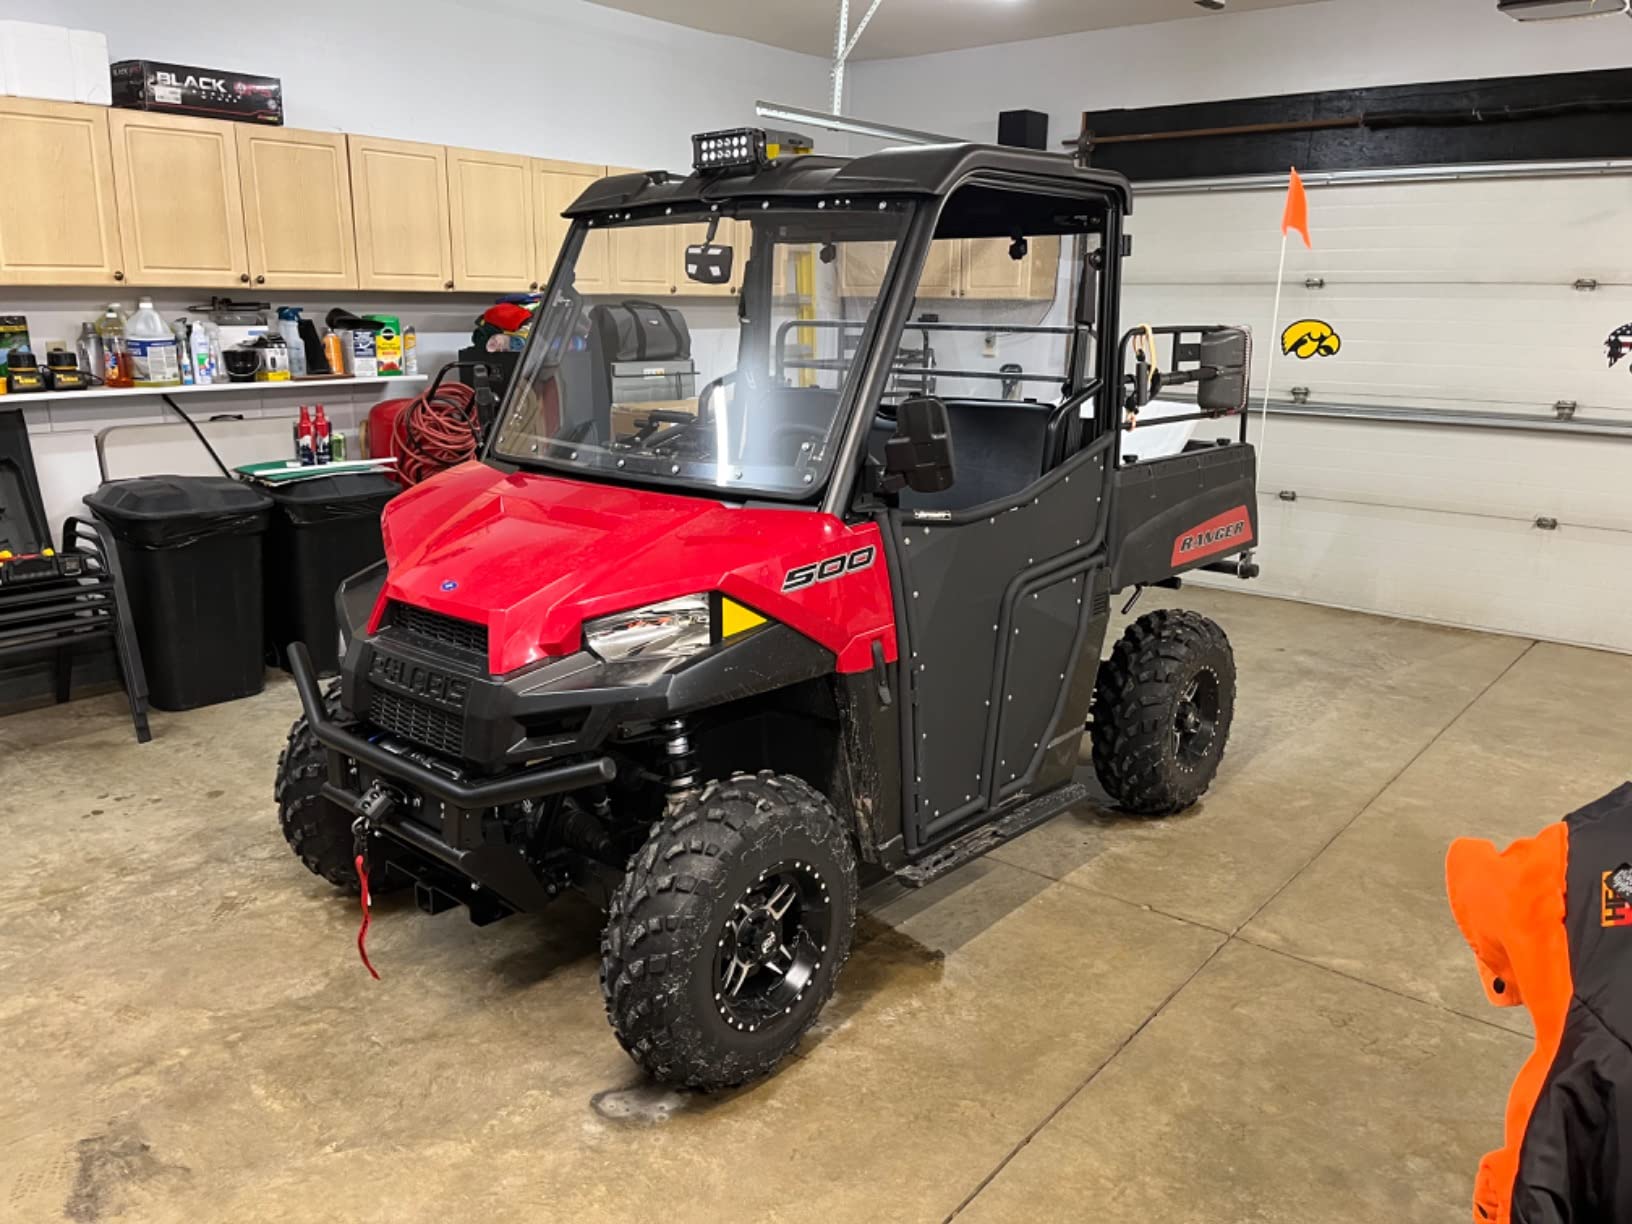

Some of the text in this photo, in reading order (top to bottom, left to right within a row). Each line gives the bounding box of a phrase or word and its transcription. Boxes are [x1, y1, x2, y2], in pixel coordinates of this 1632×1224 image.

[156, 71, 228, 92] BLACK
[1179, 520, 1245, 553] RANGER
[781, 543, 877, 595] 500
[367, 650, 467, 708] POLARIS
